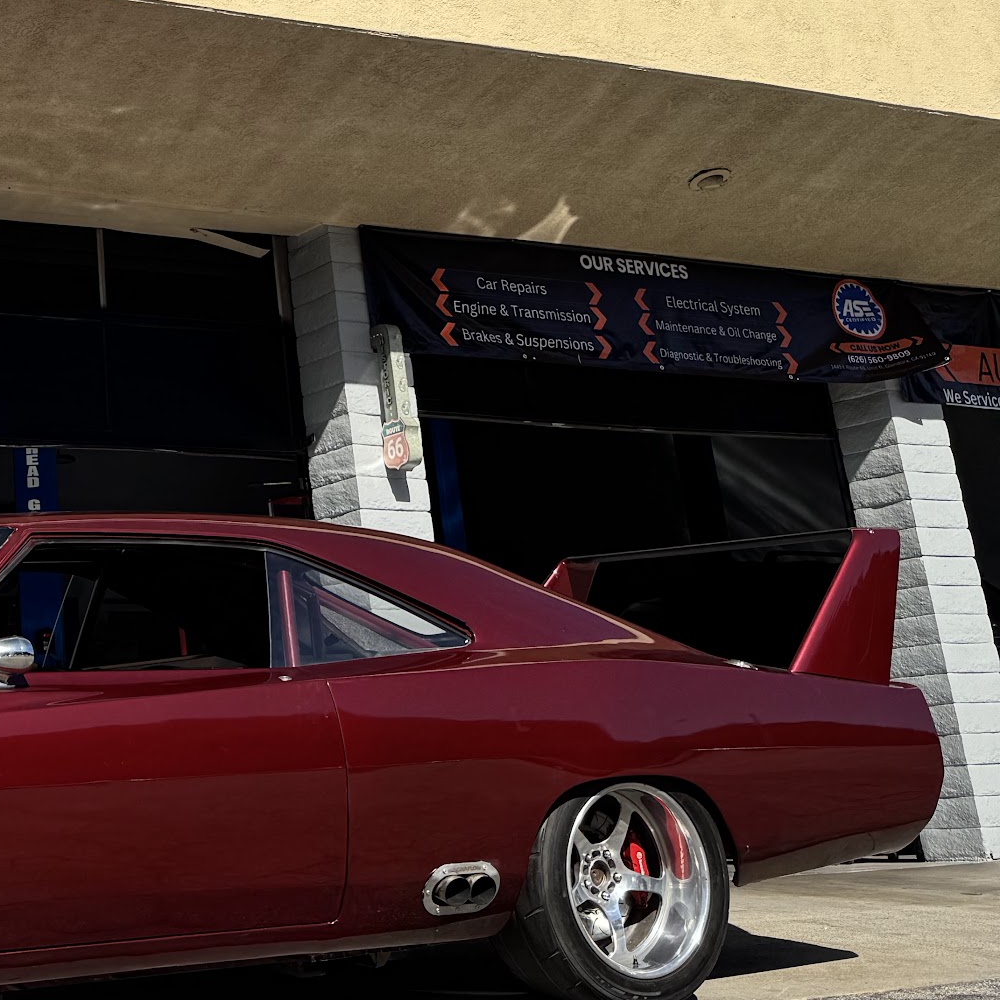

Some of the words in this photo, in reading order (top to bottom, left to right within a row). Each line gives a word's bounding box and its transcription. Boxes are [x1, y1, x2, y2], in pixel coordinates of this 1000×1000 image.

[579, 253, 613, 273] OUR
[615, 257, 689, 280] SERVICES
[476, 276, 498, 291] Car
[500, 279, 548, 296] Repairs
[453, 300, 497, 318] Engine
[499, 303, 509, 317] &
[511, 304, 592, 324] Transmission
[665, 295, 718, 313] Electrical
[720, 300, 761, 318] System
[842, 298, 875, 318] ASE
[462, 327, 502, 344] Brakes
[505, 332, 514, 346] &
[516, 333, 595, 353] Suspensions
[655, 319, 717, 336] Maintenance
[718, 325, 726, 336] &
[727, 324, 741, 338] Oil
[742, 327, 777, 343] Change
[659, 347, 705, 363] Diagnostic
[706, 352, 713, 362] &
[713, 352, 783, 370] Troubleshooting
[847, 354, 867, 364] (626)
[867, 349, 911, 364] 560-9809
[850, 344, 867, 352] CALL
[867, 345, 877, 353] US
[878, 342, 900, 353] NOW
[943, 388, 962, 404] We
[385, 425, 402, 436] ROUTE
[387, 436, 404, 460] 66
